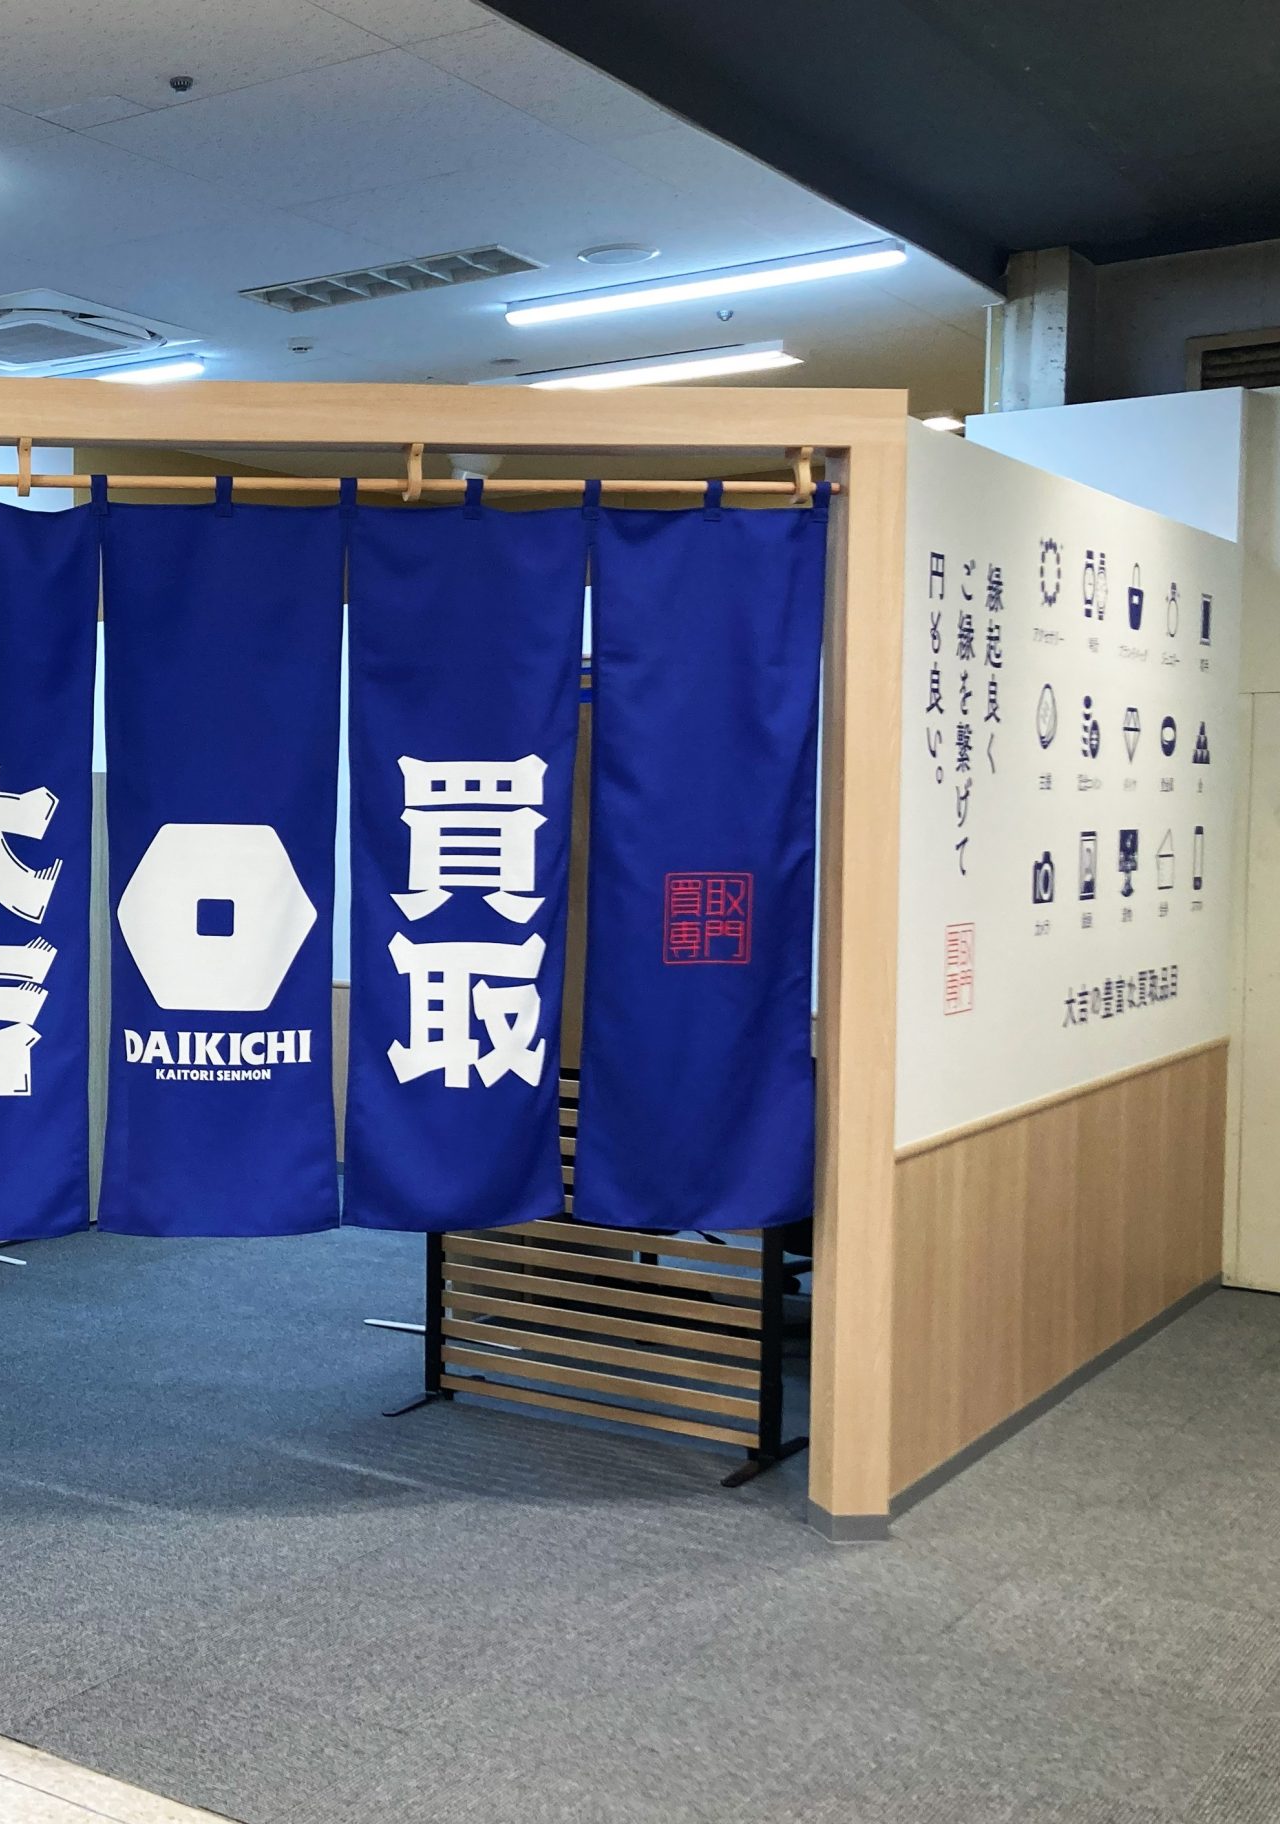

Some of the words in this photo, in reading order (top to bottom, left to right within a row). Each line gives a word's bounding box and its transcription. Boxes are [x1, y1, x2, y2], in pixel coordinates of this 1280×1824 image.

[984, 563, 1004, 774] 縁起良く
[387, 754, 548, 1087] 買取
[124, 1028, 312, 1066] DAIKICHI
[156, 1068, 214, 1081] KAITORI
[216, 1069, 271, 1082] SENMON
